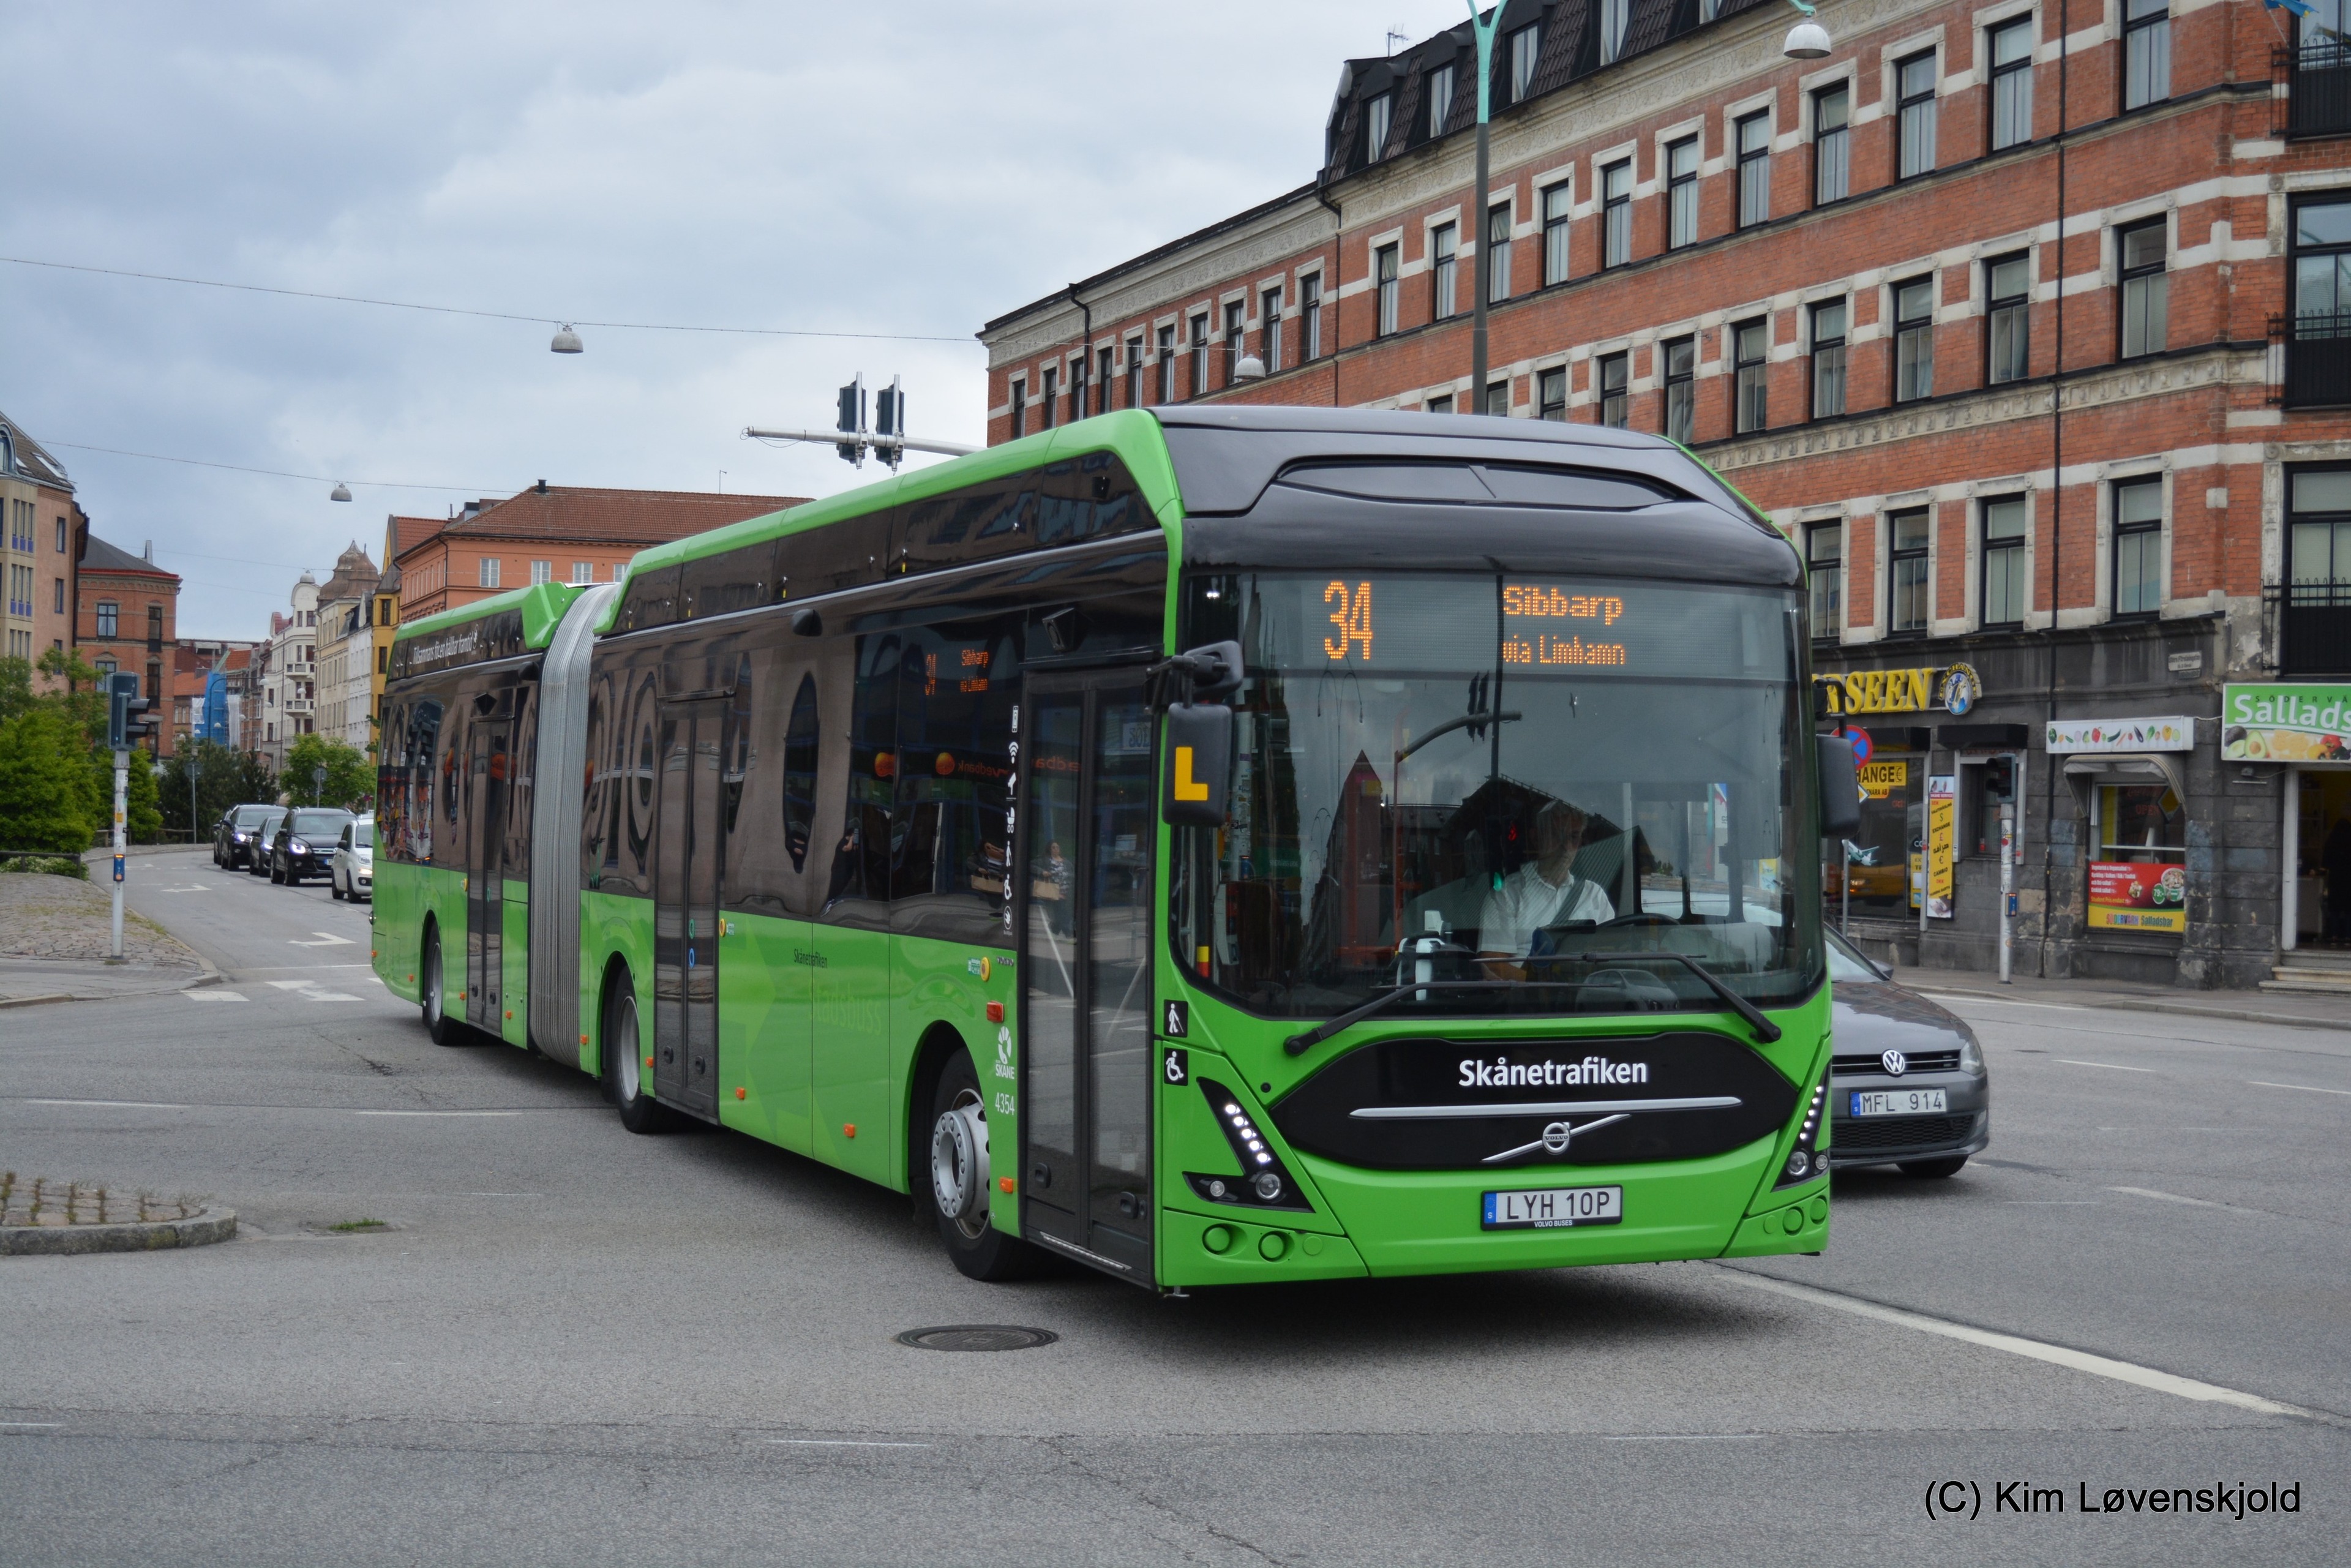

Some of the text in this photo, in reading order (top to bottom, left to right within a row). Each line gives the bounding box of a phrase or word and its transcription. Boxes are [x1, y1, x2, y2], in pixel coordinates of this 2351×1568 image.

[1324, 581, 1622, 659] 34 Sibbarp
[413, 645, 434, 664] Tillsammans
[458, 631, 473, 653] framtid
[1503, 634, 1625, 665] via Limhamn
[925, 654, 936, 695] 34
[2141, 915, 2173, 927] Salladsbar
[794, 948, 828, 969] Skånetrafiken
[1458, 1057, 1647, 1086] Skånetrafiken
[995, 1092, 1014, 1116] 4354
[1862, 1095, 1895, 1112] MFL
[1910, 1092, 1942, 1110] 914
[1506, 1193, 1554, 1220] LYH
[1565, 1191, 1610, 1217] 10P
